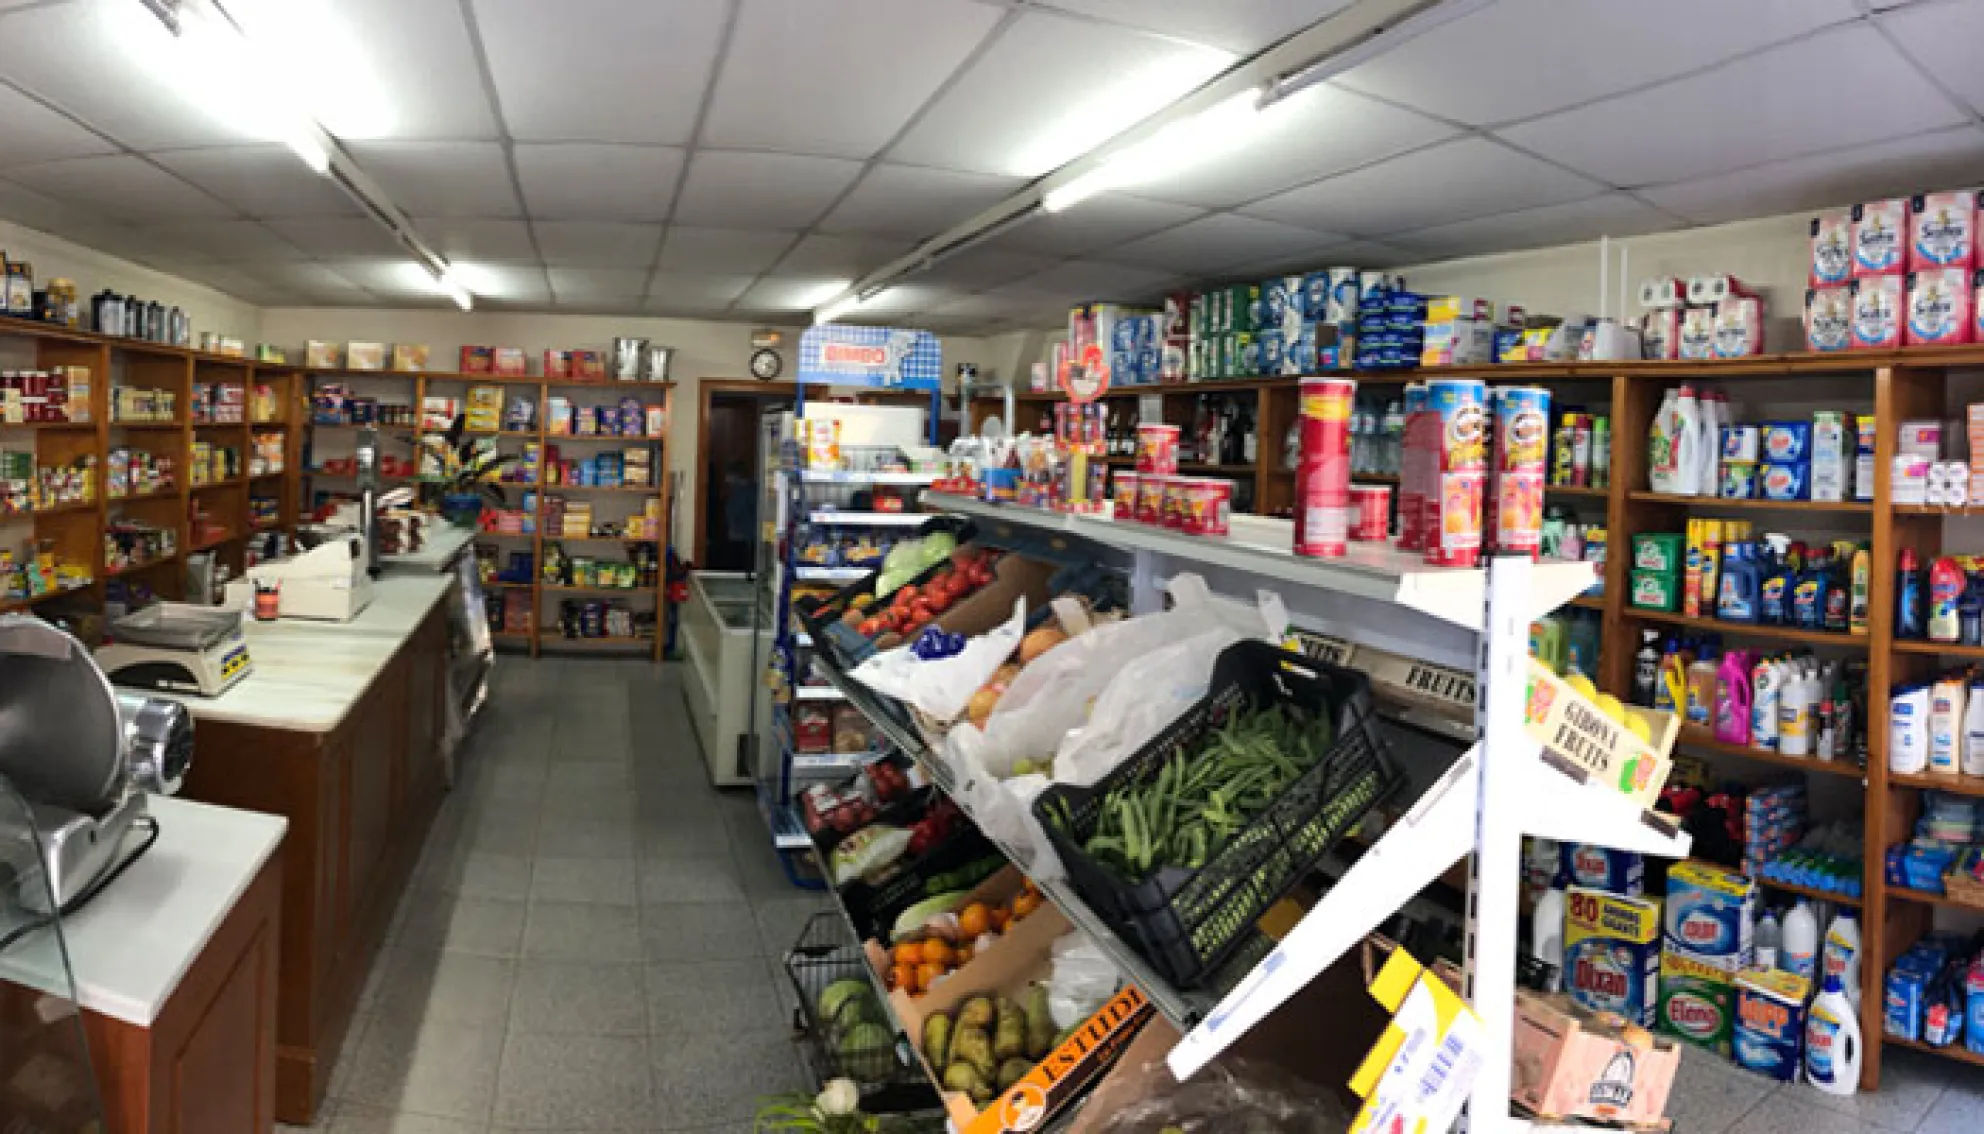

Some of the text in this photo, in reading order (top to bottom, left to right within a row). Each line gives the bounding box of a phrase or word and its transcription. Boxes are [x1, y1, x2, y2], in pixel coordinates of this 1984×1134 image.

[1553, 722, 1610, 772] FRUITS
[1569, 892, 1599, 922] 80
[1575, 958, 1627, 998] Dixan
